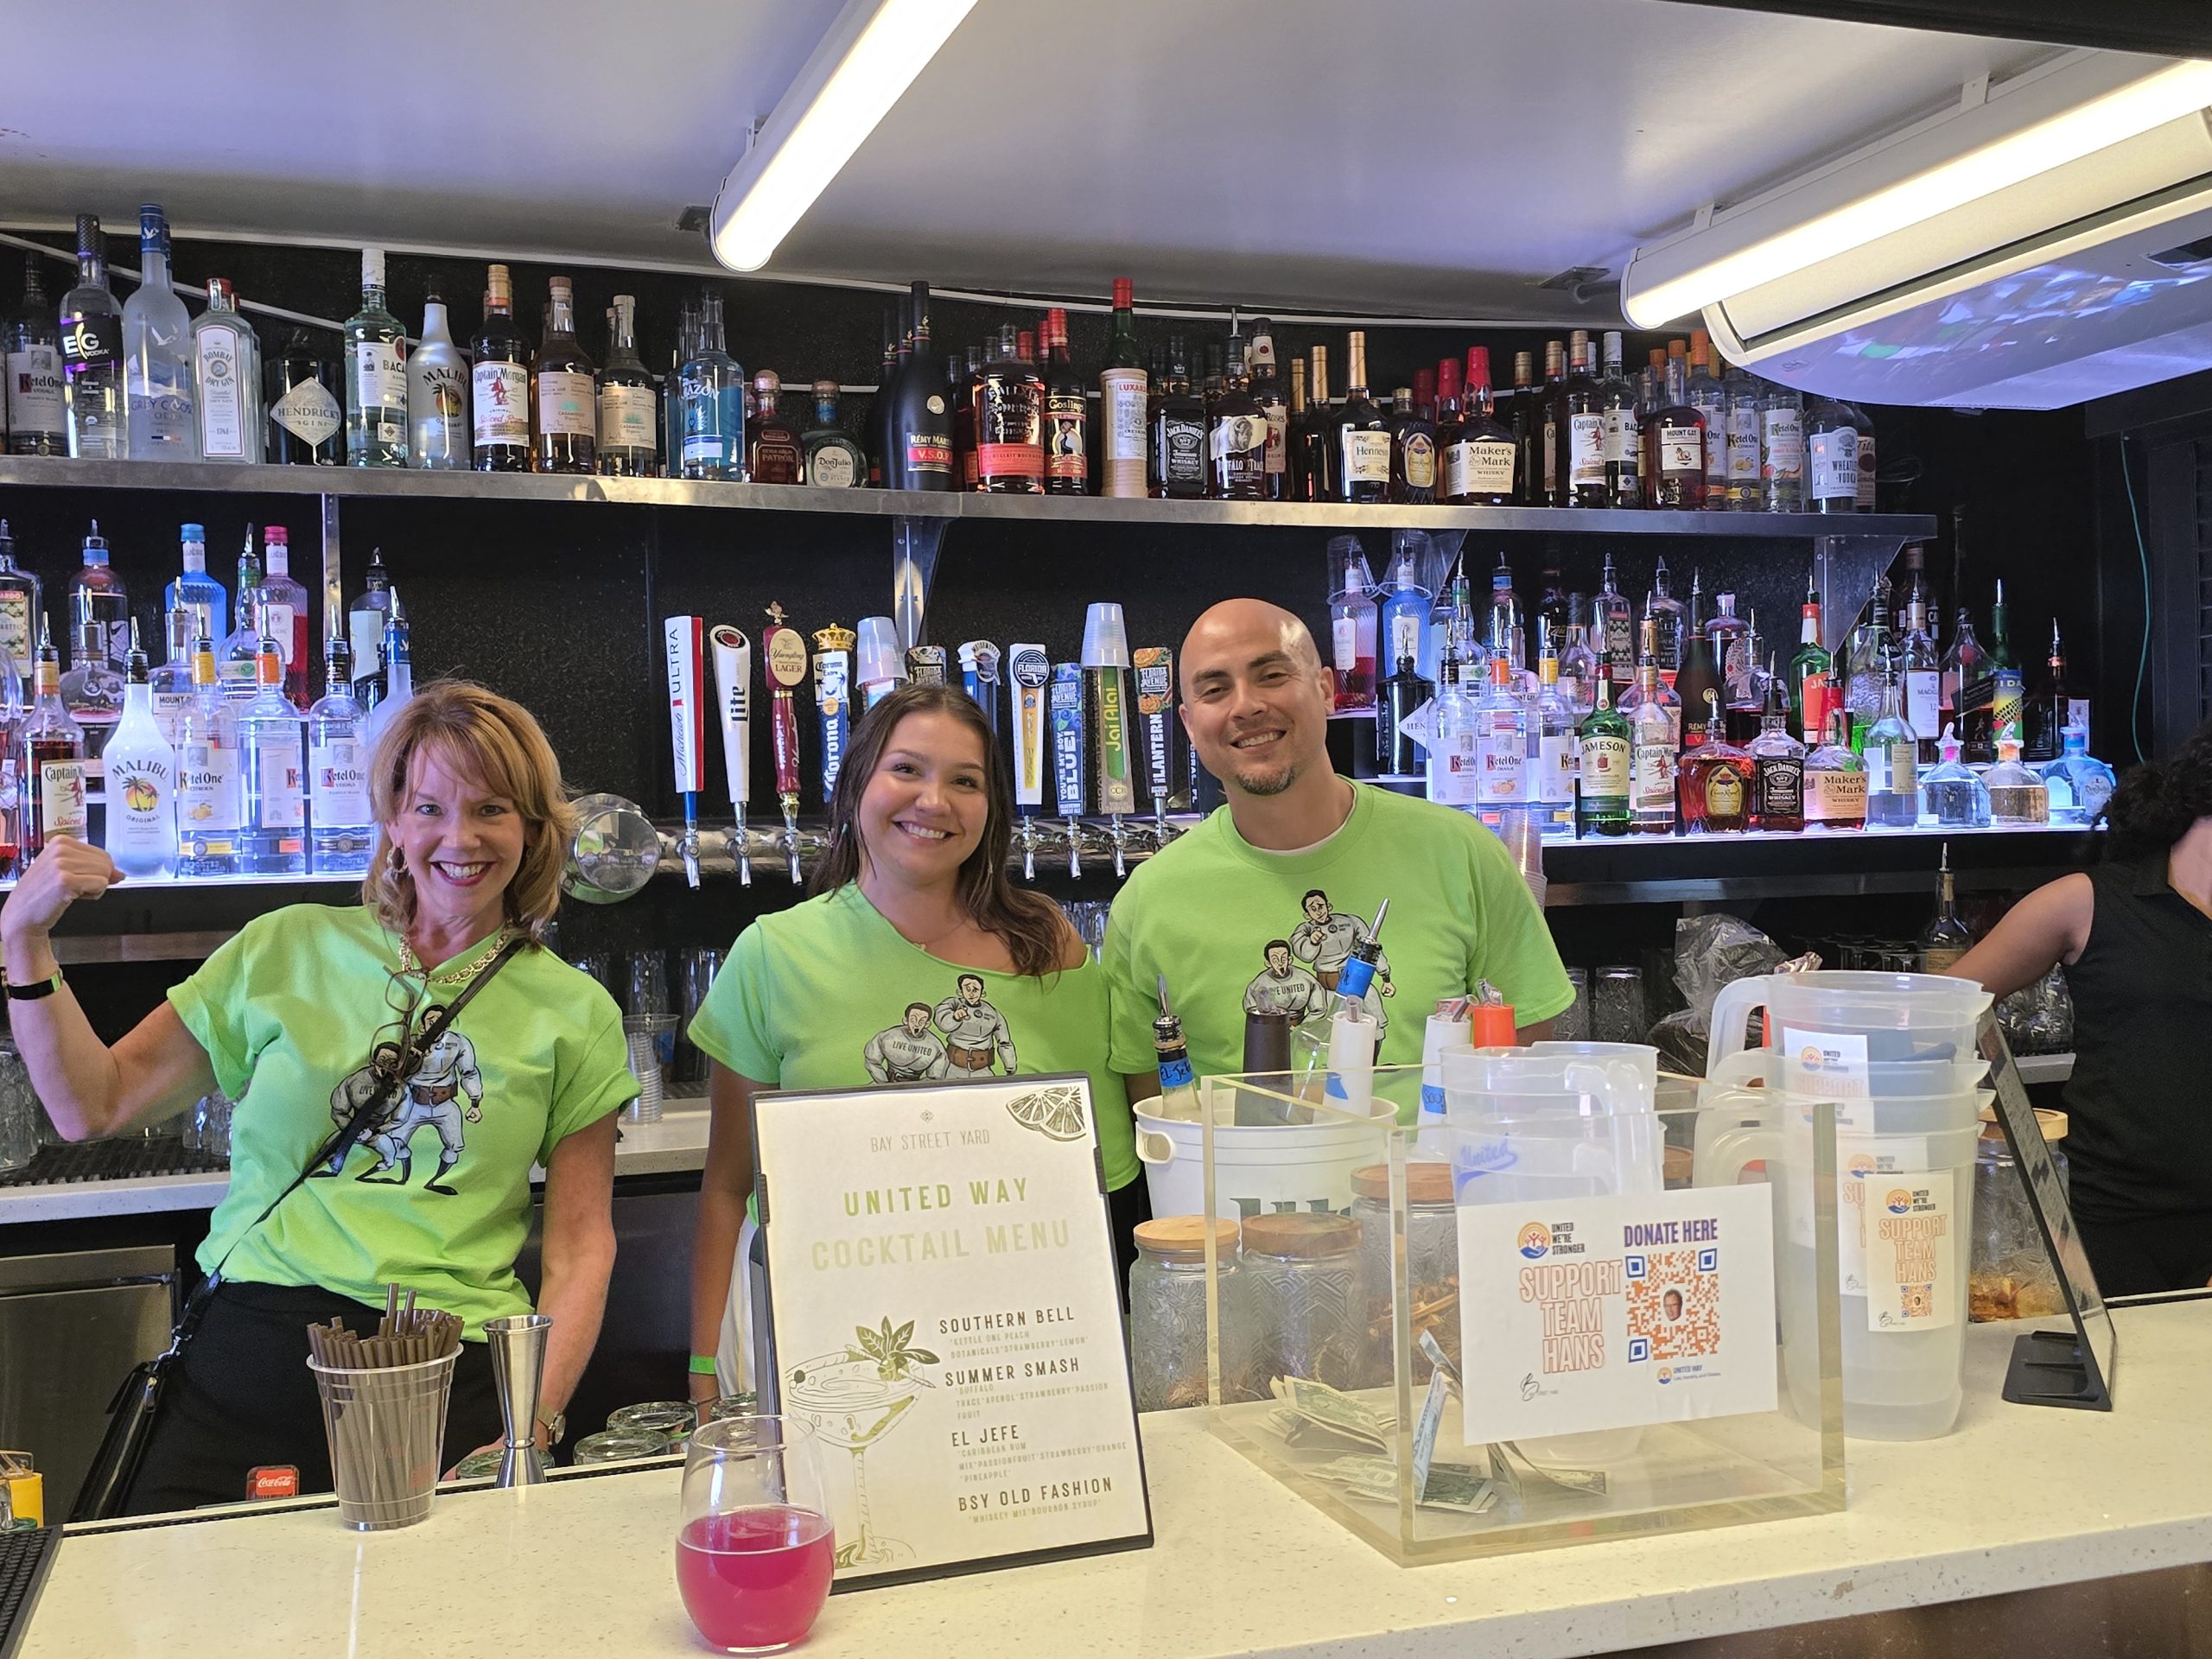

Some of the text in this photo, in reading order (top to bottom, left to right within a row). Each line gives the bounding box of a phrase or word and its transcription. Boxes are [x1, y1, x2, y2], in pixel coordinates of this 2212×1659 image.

[203, 351, 233, 362] BOMBAY
[206, 376, 235, 387] DRY GIN
[474, 367, 527, 384] Captain Morgan
[19, 375, 47, 392] Ketel
[1166, 424, 1205, 440] JACK DANIEL'S
[1573, 418, 1598, 431] Captain
[910, 434, 931, 444] RÉMY
[1728, 434, 1748, 448] Ketel
[1469, 446, 1512, 455] Maker's
[817, 457, 851, 469] Don Julio
[1481, 458, 1510, 467] Mark
[669, 627, 681, 694] ULTRA
[770, 648, 804, 663] Yuengling
[775, 664, 803, 673] LAGER
[816, 661, 842, 672] Corona
[1017, 664, 1047, 675] FLORIDA
[1141, 677, 1167, 688] AVENUE
[1103, 687, 1122, 752] Jai Alai
[673, 712, 688, 777] Michelob
[1581, 741, 1626, 755] JAMESON
[824, 717, 839, 791] Corona
[1058, 751, 1065, 766] MY
[1637, 747, 1662, 761] Captain
[112, 760, 169, 782] MALIBU
[1065, 730, 1079, 800] BLUE!
[1486, 754, 1522, 774] Ketel One
[1764, 763, 1801, 777] JACK DANIEL'S
[45, 766, 77, 782] Captain
[180, 769, 222, 792] Ktel One
[321, 768, 349, 787] Ketel
[1192, 788, 1198, 804] FL
[1836, 785, 1866, 794] Mark
[54, 816, 80, 826] Spiced
[125, 815, 161, 823] ORIGINAL
[1281, 983, 1306, 994] UNITED
[892, 1041, 932, 1057] LIVE UNITED
[1823, 1050, 1840, 1058] UNITED
[359, 1085, 372, 1096] LIVE
[870, 1128, 990, 1153] BAY STREET YARD
[843, 1177, 1028, 1217] UNITED WAY
[1551, 1222, 1574, 1233] UNITED
[1624, 1217, 1719, 1248] DONATE HERE
[1878, 1214, 1948, 1240] SUPPORT
[810, 1219, 1070, 1272] COCKTAIL MENU
[1552, 1233, 1572, 1244] WE'RE
[1552, 1243, 1586, 1256] STRONGER
[1894, 1239, 1936, 1262] TEAM
[1895, 1261, 1936, 1284] HANS
[1518, 1259, 1624, 1303] SUPPORT
[939, 1306, 1075, 1334] SOUTHERN BELL
[1540, 1297, 1603, 1338] TEAM
[1541, 1333, 1605, 1375] HANS
[945, 1357, 1079, 1388] SUMMER SMASH
[1673, 1365, 1690, 1374] UNITED
[957, 1409, 981, 1421] FRUIT
[951, 1424, 1020, 1447] EL JEFE
[1009, 1442, 1027, 1452] RUM
[257, 1475, 293, 1488] Coca-Cola
[958, 1477, 1113, 1511] BSY OLD FASHION
